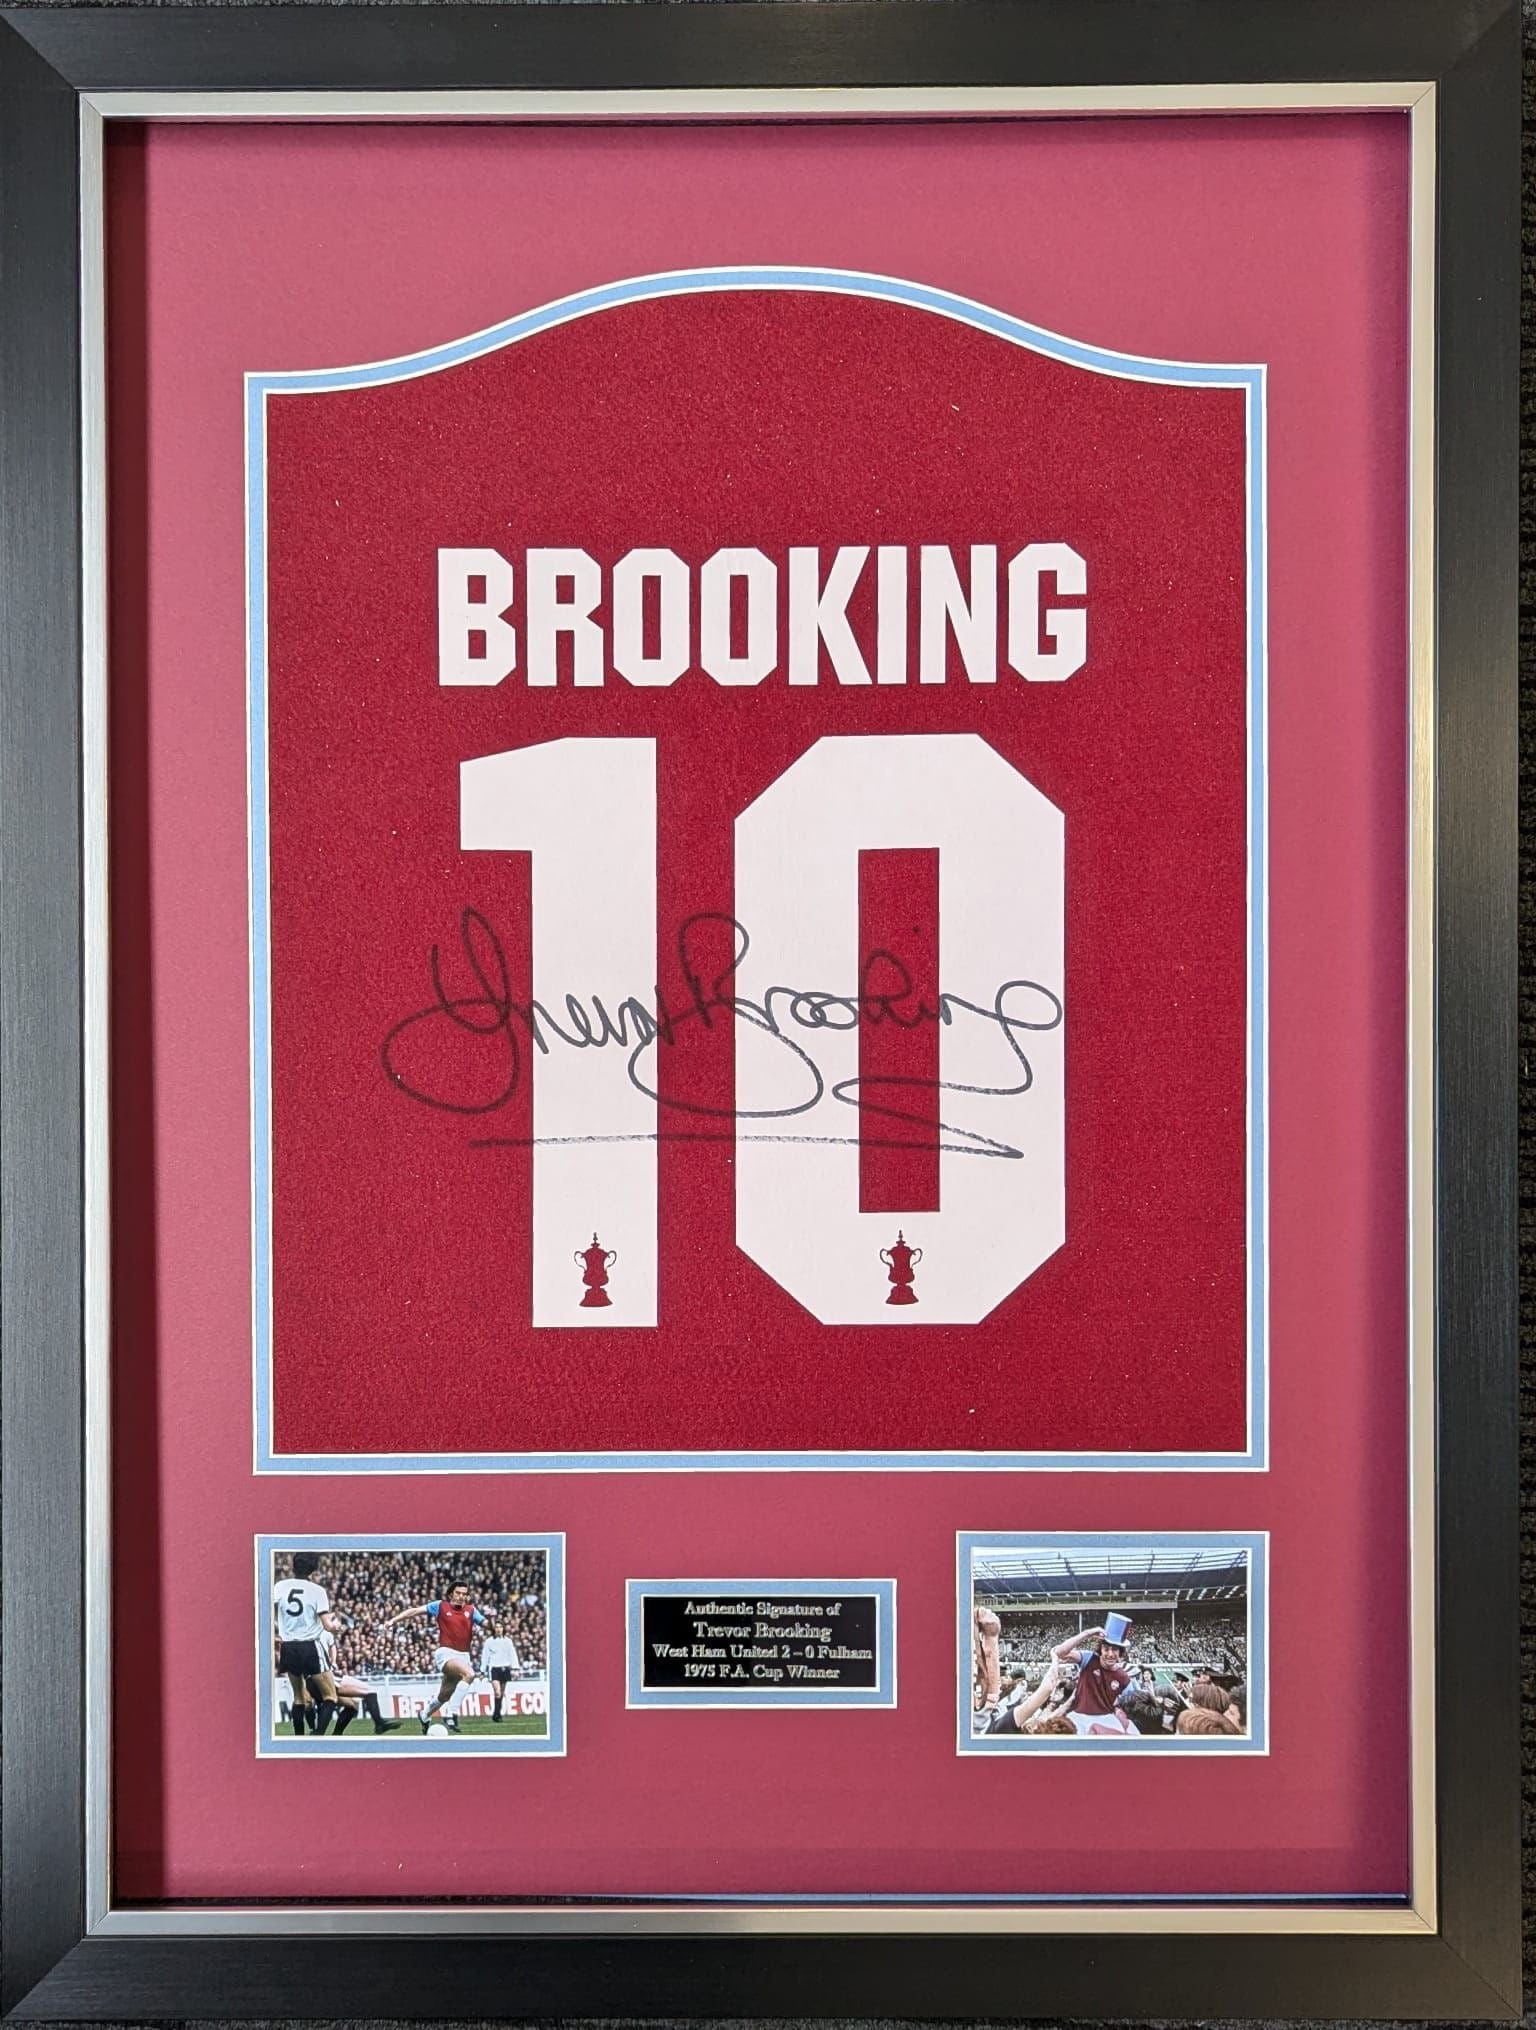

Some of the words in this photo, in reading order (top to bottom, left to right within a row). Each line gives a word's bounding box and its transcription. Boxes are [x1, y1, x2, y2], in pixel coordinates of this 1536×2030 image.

[438, 543, 1088, 687] BROOKING
[460, 733, 1066, 1330] 10
[286, 1588, 305, 1617] 5
[684, 1600, 754, 1616] Authentic
[756, 1601, 824, 1619] Signature
[826, 1602, 843, 1616] of
[693, 1621, 752, 1638] Trevor
[754, 1622, 833, 1643] Brooking
[652, 1643, 689, 1658] West
[691, 1644, 727, 1658] Ham
[729, 1644, 779, 1659] United
[781, 1644, 791, 1659] 2
[804, 1644, 815, 1659] 0
[817, 1645, 873, 1660] Fulham
[684, 1663, 716, 1678] 1975
[719, 1663, 750, 1679] F.A.
[753, 1663, 784, 1682] Cup
[786, 1664, 841, 1679] Winner
